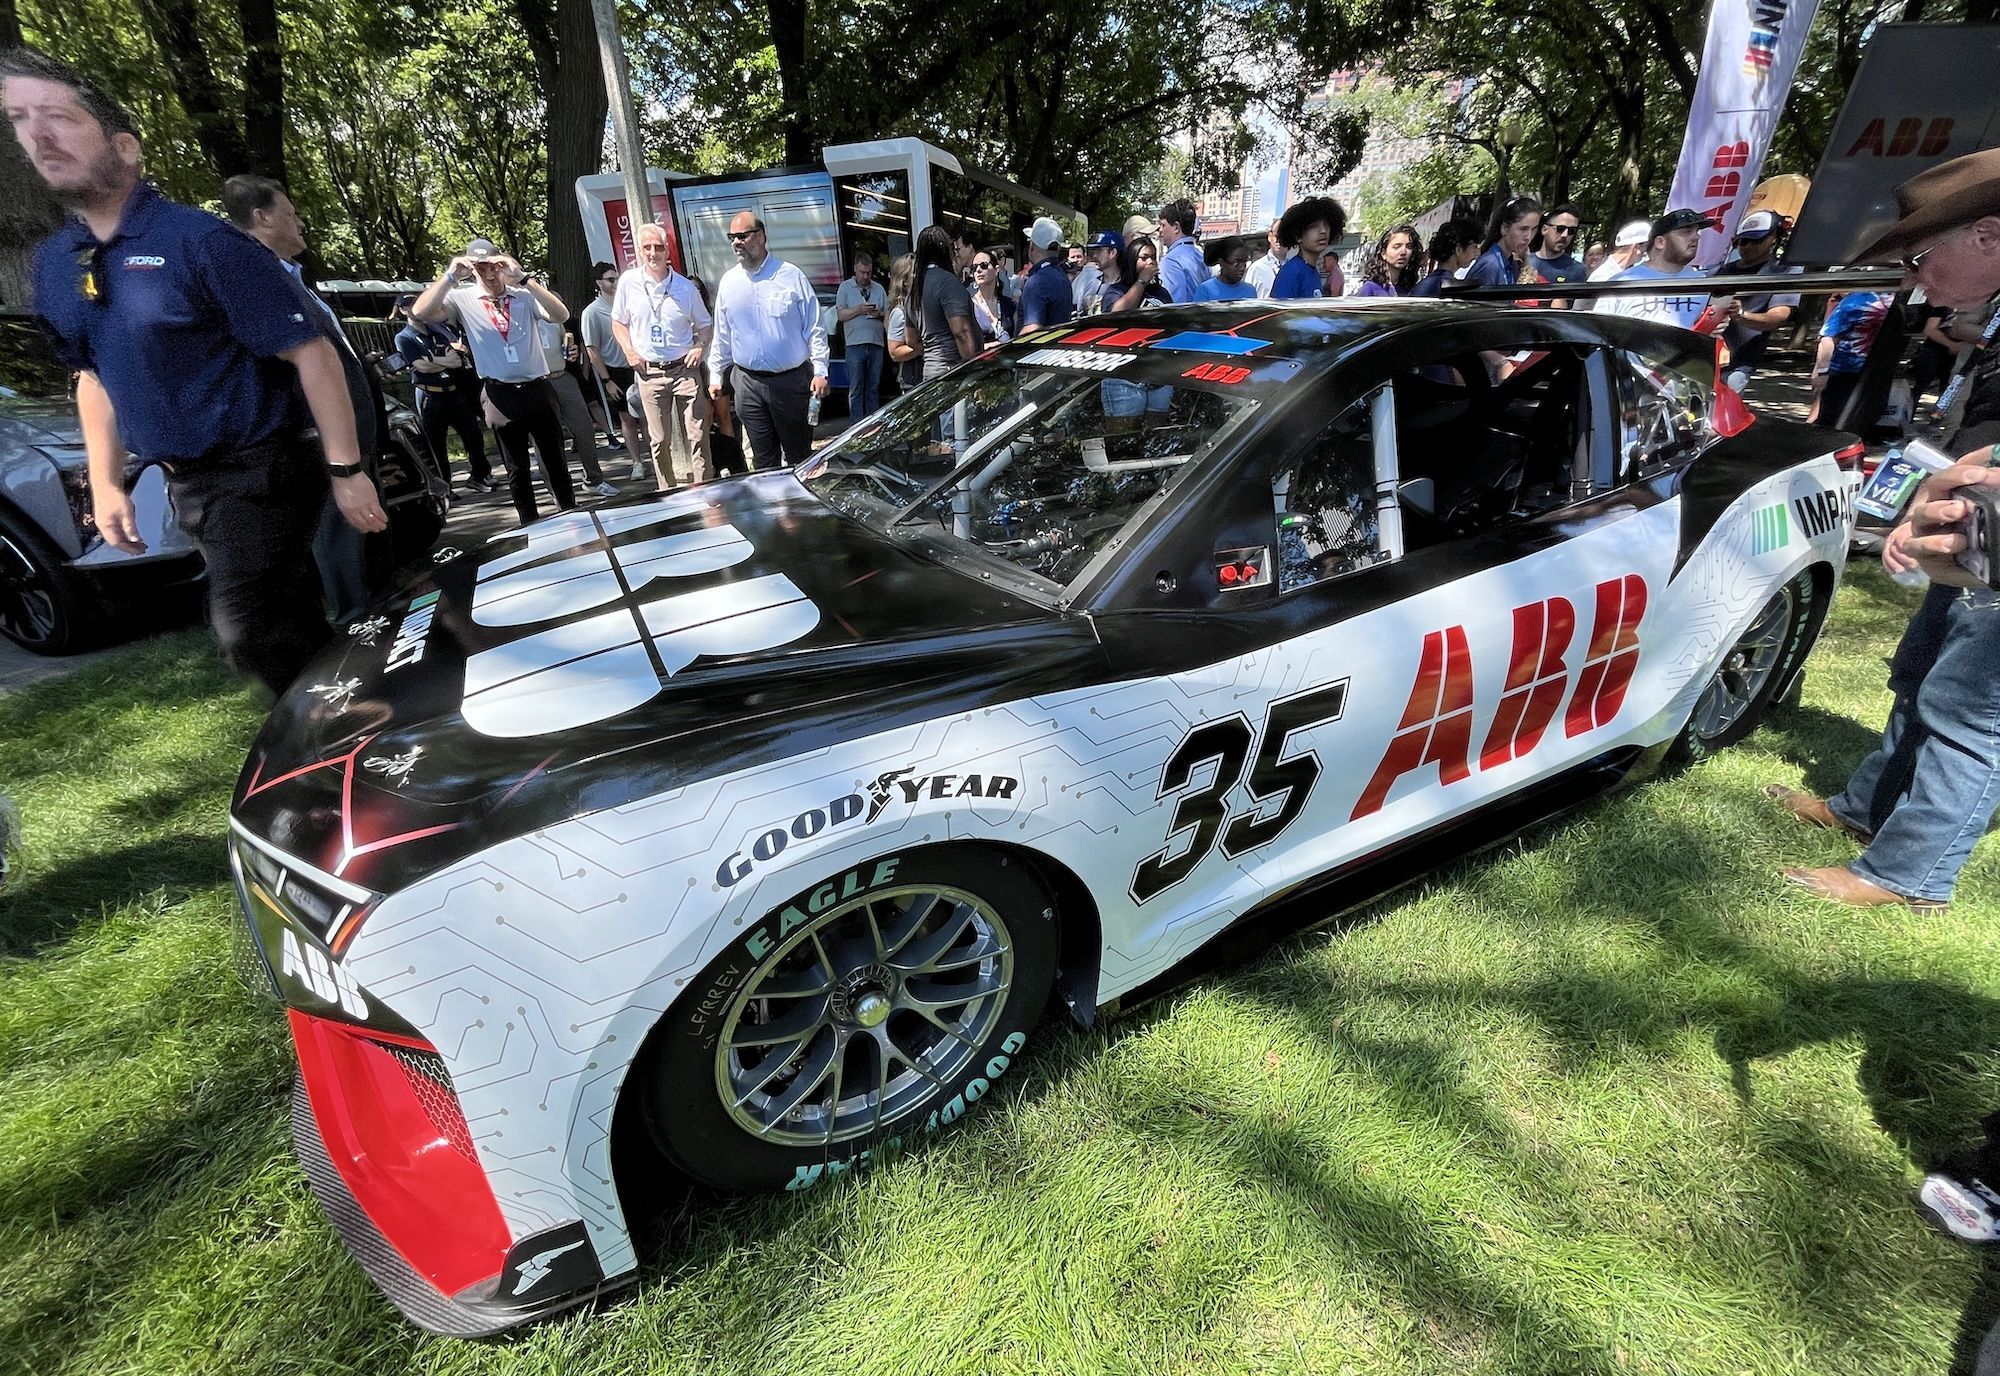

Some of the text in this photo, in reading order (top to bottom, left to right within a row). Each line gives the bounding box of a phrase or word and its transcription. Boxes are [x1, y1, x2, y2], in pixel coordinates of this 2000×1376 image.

[1846, 117, 1955, 157] ABB
[1703, 140, 1750, 234] ABB
[127, 256, 166, 267] FORD
[1017, 349, 1138, 371] NASCAR
[1181, 363, 1252, 384] ABB
[383, 603, 438, 674] IMPACT
[1349, 573, 1649, 823] ABB
[1127, 676, 1351, 907] 35
[745, 858, 900, 961] EAGLE
[283, 927, 369, 1021] ABB
